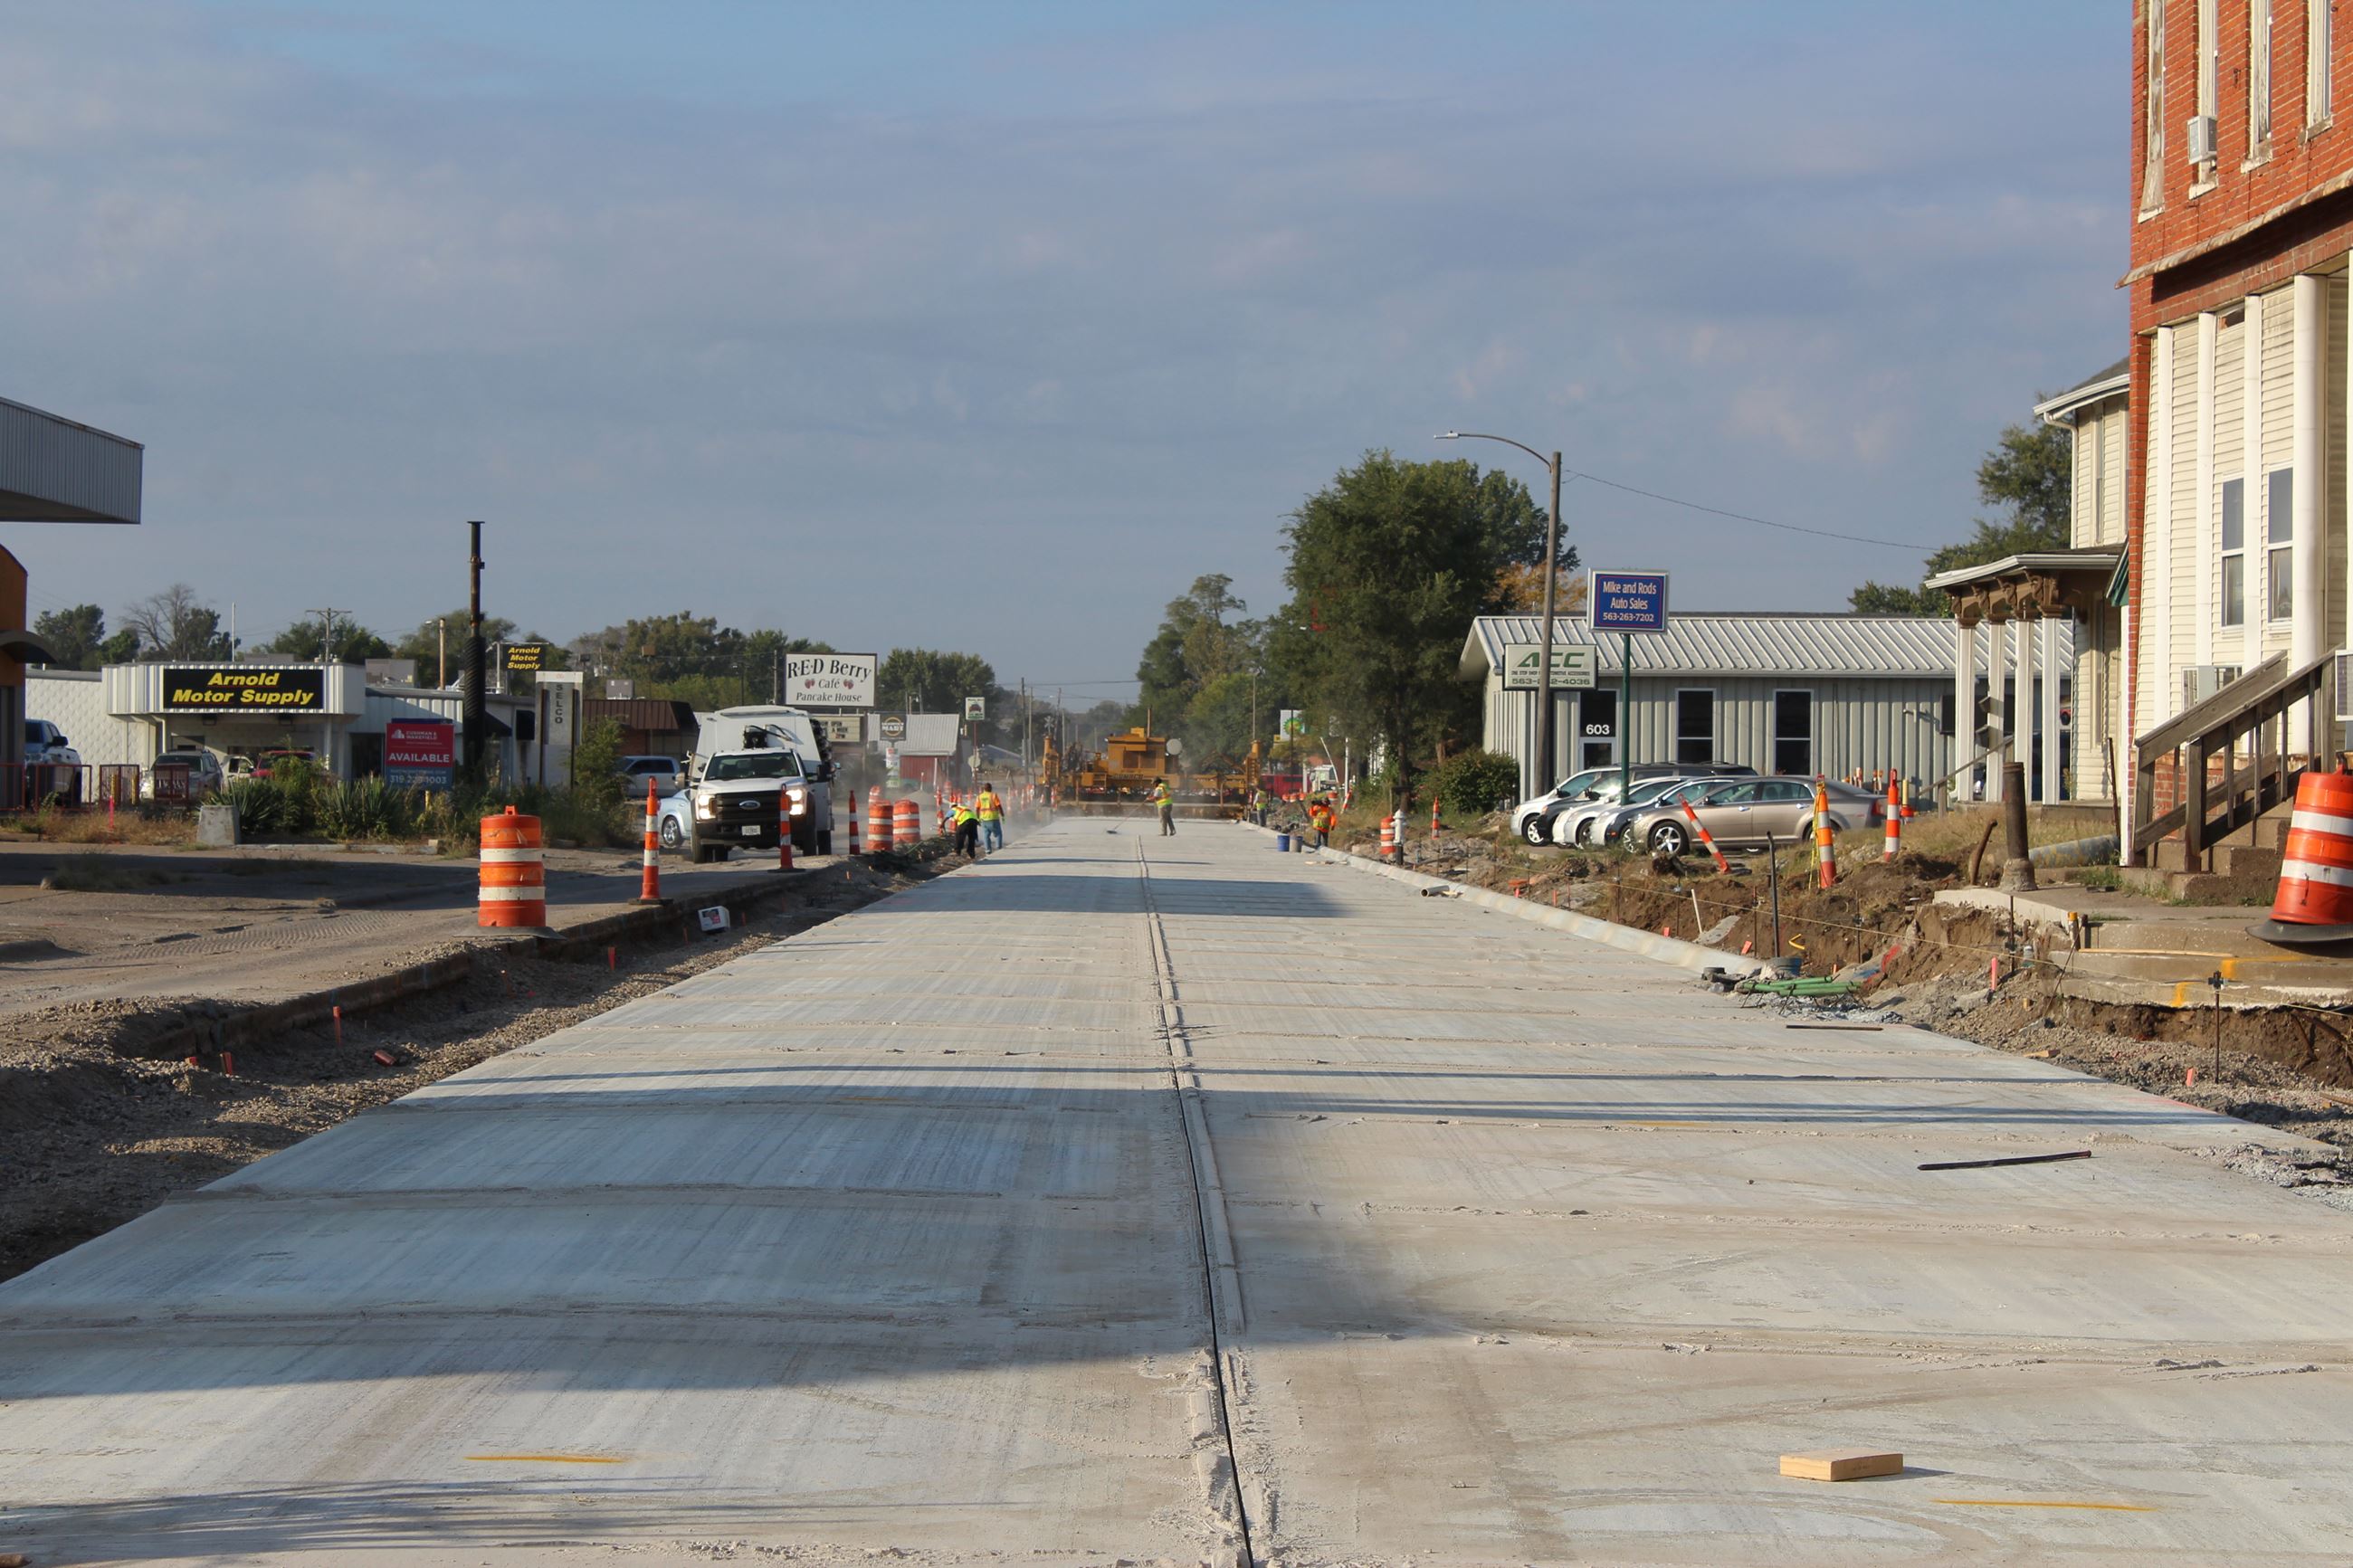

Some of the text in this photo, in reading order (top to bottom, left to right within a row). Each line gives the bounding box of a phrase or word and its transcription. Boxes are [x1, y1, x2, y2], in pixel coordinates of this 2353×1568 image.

[1603, 581, 1657, 594] Mike and Rods
[1611, 597, 1648, 610] Auto Sales
[830, 660, 872, 683] Berry
[207, 672, 280, 686] Arnold
[818, 678, 840, 689] Café
[173, 689, 314, 705] Motor Supply
[796, 692, 862, 702] Pancake House
[555, 684, 563, 724] SELCO
[1586, 724, 1610, 735] 603
[388, 753, 450, 763] AVAILABLE
